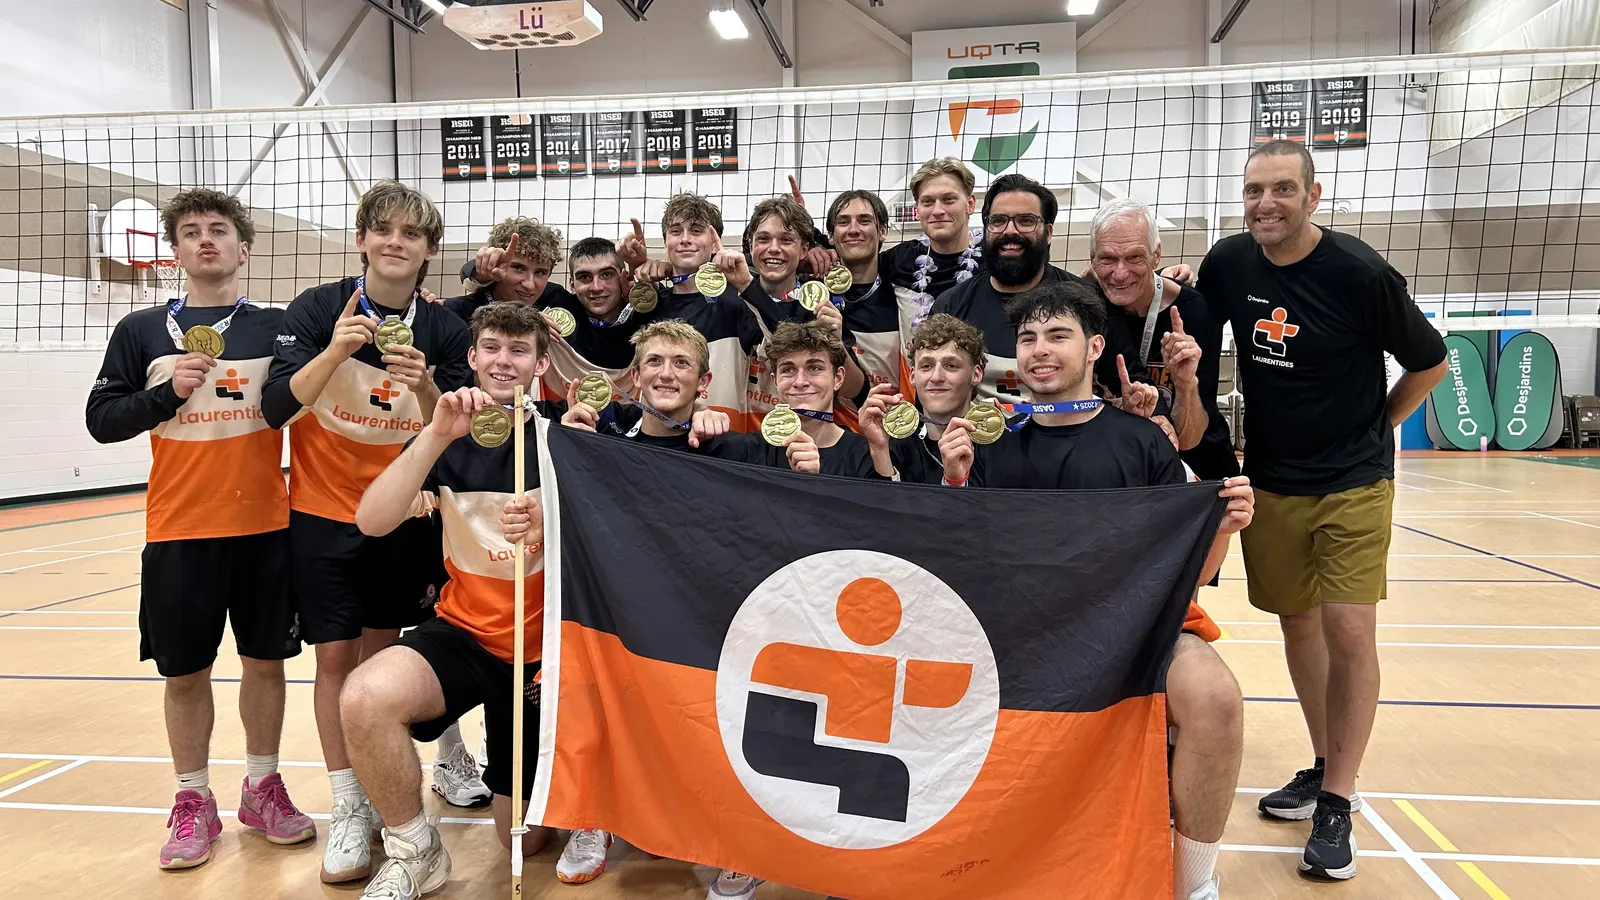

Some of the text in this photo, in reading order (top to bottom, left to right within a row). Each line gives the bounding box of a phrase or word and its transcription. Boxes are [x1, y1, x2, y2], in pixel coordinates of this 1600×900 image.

[519, 6, 543, 30] Lü
[947, 41, 1040, 59] UQTR
[1267, 83, 1294, 92] RSEQ
[702, 108, 725, 117] RSEQ
[1261, 110, 1300, 127] 2019
[1321, 107, 1361, 125] 2019
[546, 140, 579, 155] 2014
[596, 138, 630, 154] 2017
[647, 136, 680, 151] 2018
[698, 133, 732, 149] 2018
[447, 144, 480, 160] 2011
[497, 142, 530, 158] 2013
[1252, 354, 1294, 368] LAURENTIDES
[1449, 348, 1470, 415] Desjardins
[1513, 345, 1533, 414] Desjardins
[1032, 404, 1055, 413] OASIS
